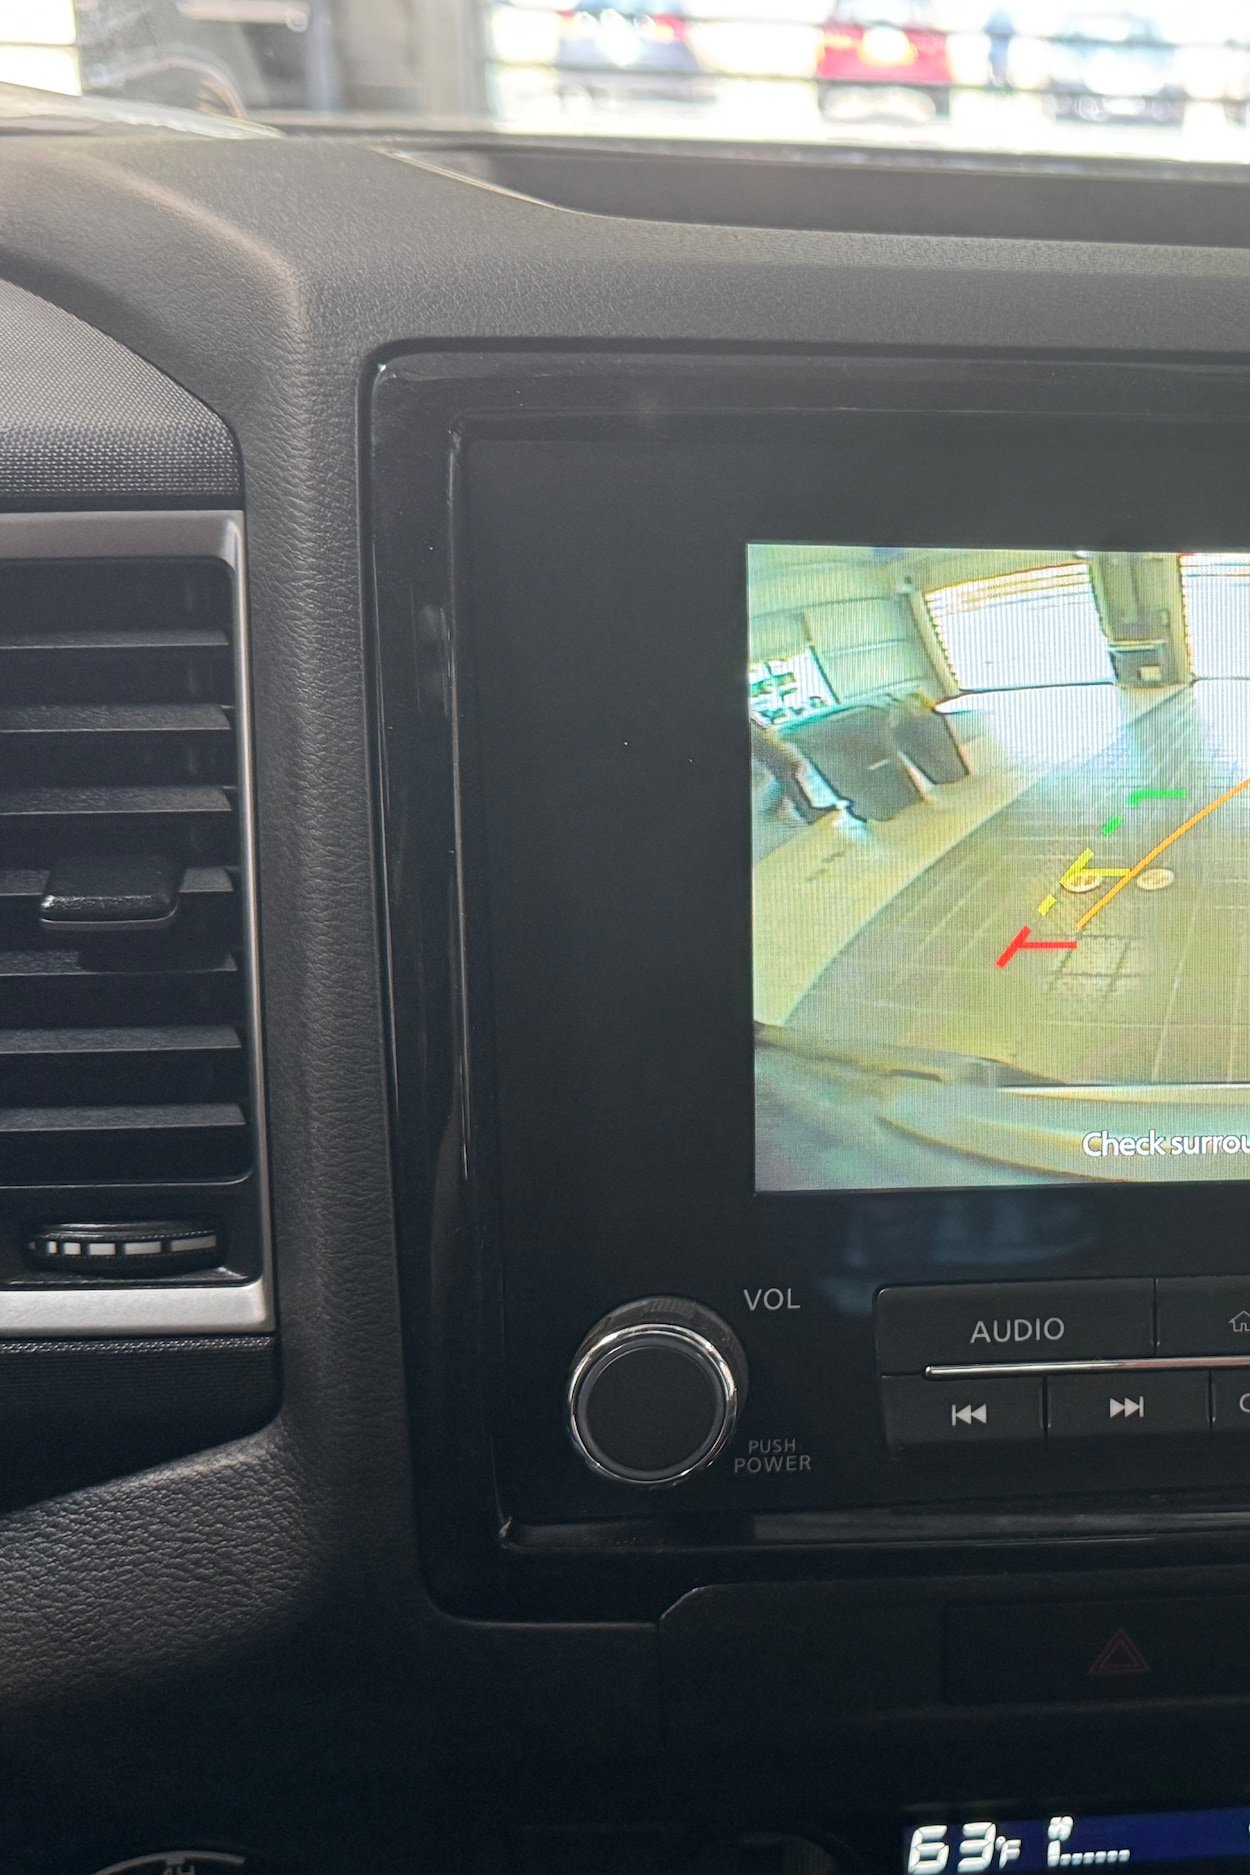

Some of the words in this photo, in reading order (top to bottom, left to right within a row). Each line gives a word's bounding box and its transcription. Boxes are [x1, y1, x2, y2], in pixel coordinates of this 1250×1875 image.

[1083, 1130, 1168, 1157] Check
[743, 1287, 801, 1311] VOL
[970, 1317, 1065, 1344] AUDIO
[748, 1438, 796, 1454] PUSH
[734, 1454, 812, 1474] POWER
